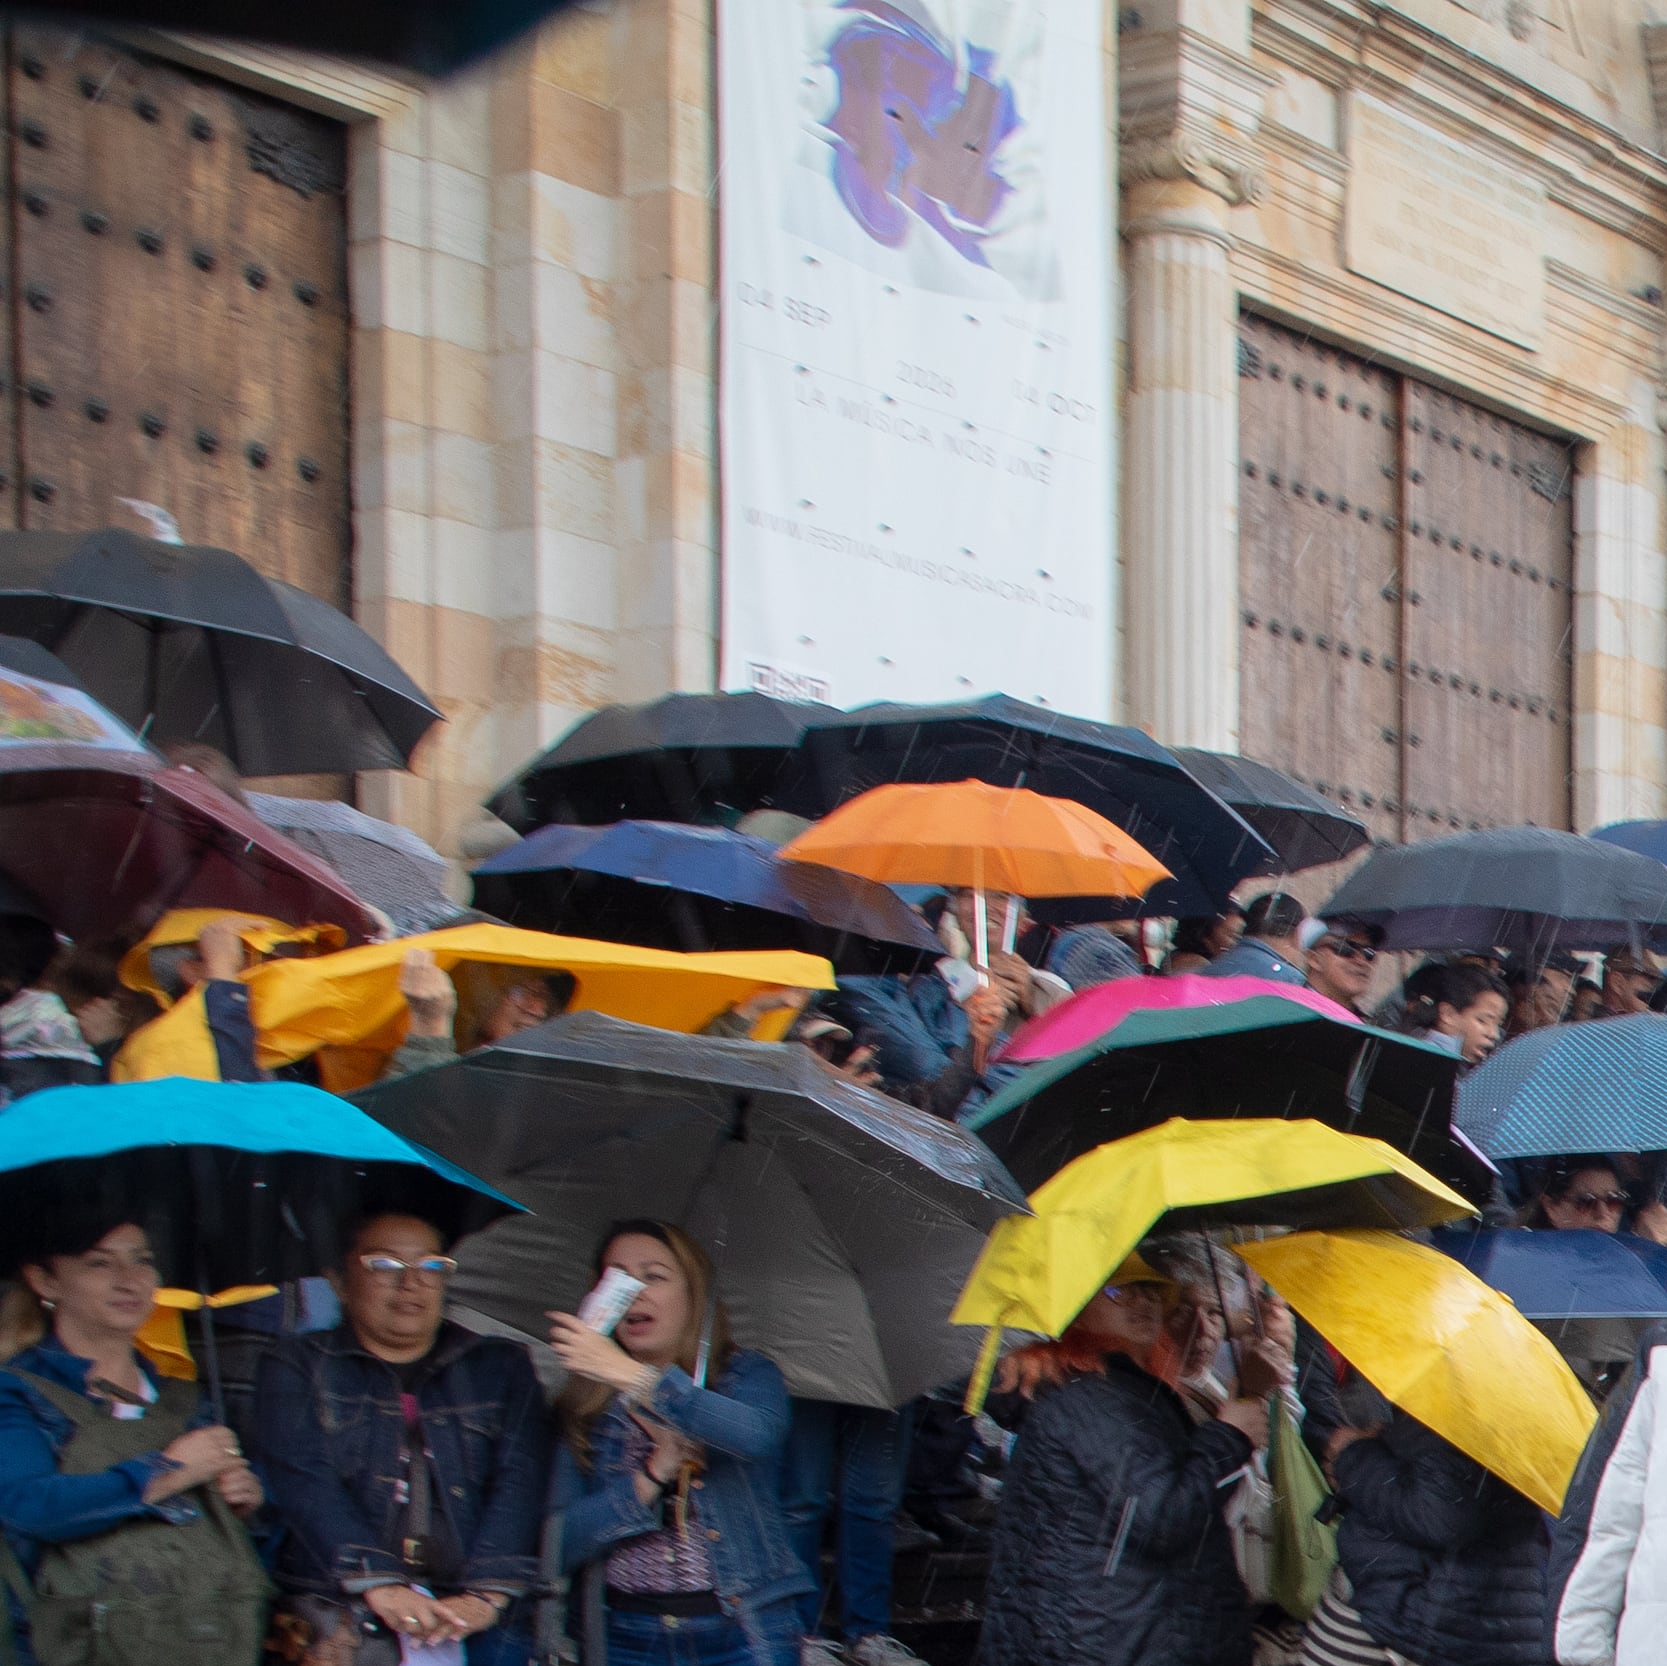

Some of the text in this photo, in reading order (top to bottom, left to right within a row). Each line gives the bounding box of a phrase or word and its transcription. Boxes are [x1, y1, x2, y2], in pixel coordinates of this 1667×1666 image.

[784, 296, 832, 330] SEP
[1047, 392, 1097, 424] OCT
[943, 433, 996, 467] NOS
